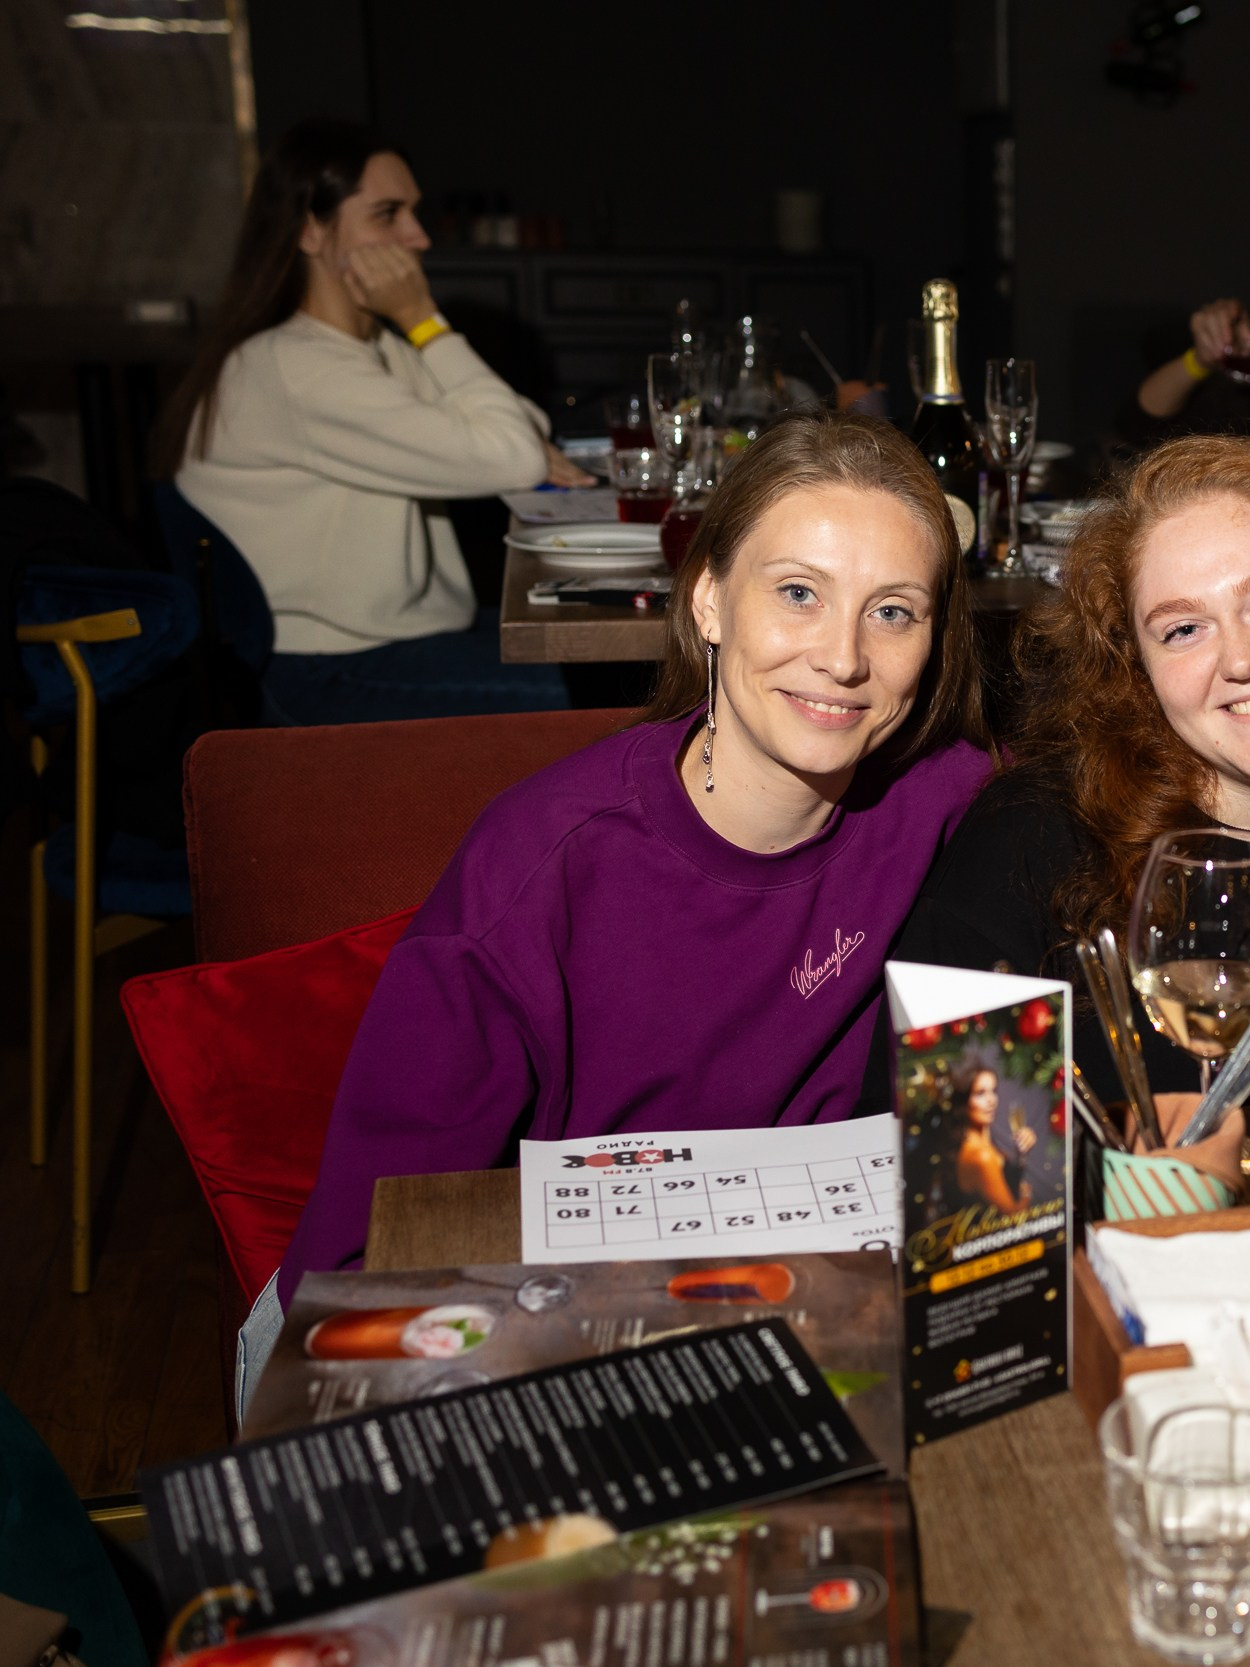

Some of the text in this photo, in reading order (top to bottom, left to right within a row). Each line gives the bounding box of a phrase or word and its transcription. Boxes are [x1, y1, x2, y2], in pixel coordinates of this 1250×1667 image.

[790, 928, 865, 996] Wrangler
[596, 1140, 655, 1150] РАДИО
[663, 1180, 696, 1191] 66
[716, 1174, 747, 1186] 54
[555, 1187, 590, 1198] 88
[611, 1184, 642, 1195] 72
[556, 1183, 857, 1219] 36 71 80
[671, 1203, 863, 1232] 33 48 52 67
